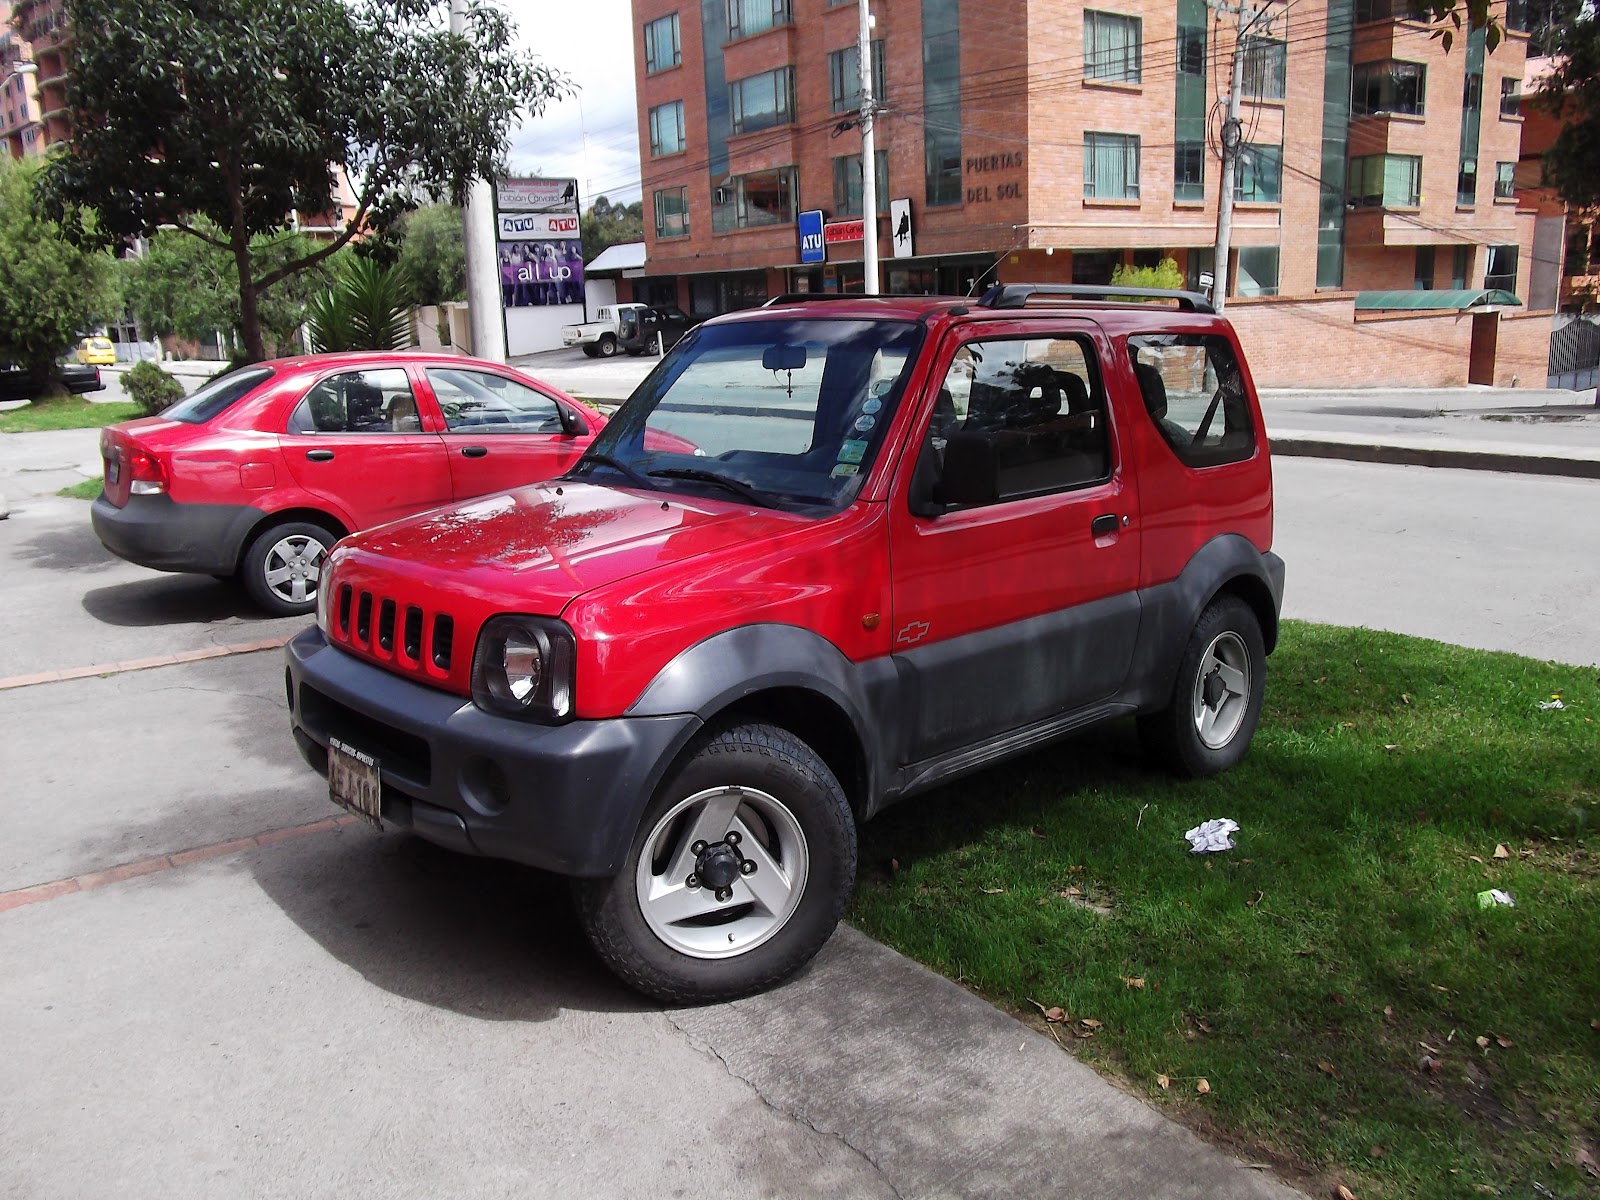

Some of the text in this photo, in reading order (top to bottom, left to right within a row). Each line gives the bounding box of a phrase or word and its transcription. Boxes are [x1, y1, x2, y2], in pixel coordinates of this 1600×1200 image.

[966, 151, 1023, 174] PUERTAS
[967, 182, 1023, 203] DEL SOL
[504, 218, 534, 232] ATU
[549, 218, 577, 231] ATU
[802, 233, 822, 250] ATU
[518, 263, 571, 280] all up
